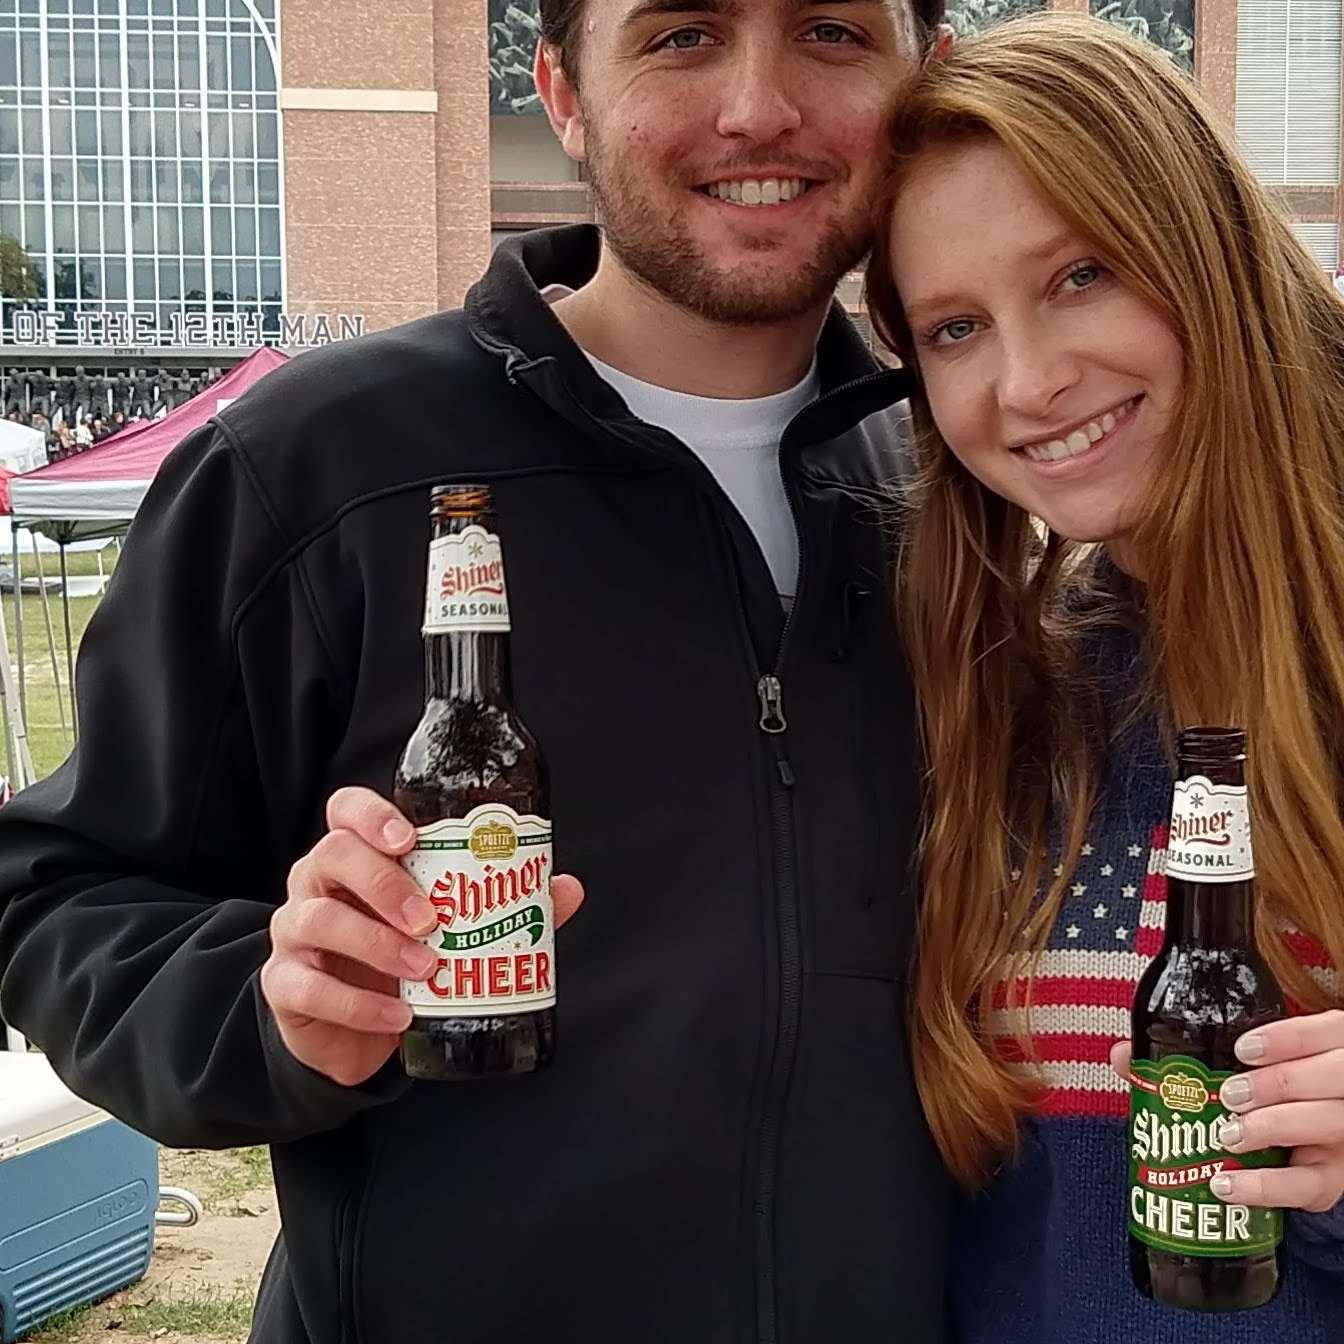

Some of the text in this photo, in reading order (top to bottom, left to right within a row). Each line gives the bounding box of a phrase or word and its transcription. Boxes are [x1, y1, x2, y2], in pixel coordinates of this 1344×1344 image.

[13, 310, 65, 346] OF
[74, 311, 155, 347] THE
[170, 311, 265, 347] 12TH
[279, 312, 365, 348] MAN
[440, 560, 501, 600] Shiner
[428, 851, 549, 929] Shiner
[455, 907, 534, 949] HOLIDAY
[426, 951, 552, 999] CHEER
[1132, 1108, 1240, 1162] Shine
[1147, 1161, 1225, 1185] HOLIDAY
[1131, 1186, 1251, 1241] CHEER
